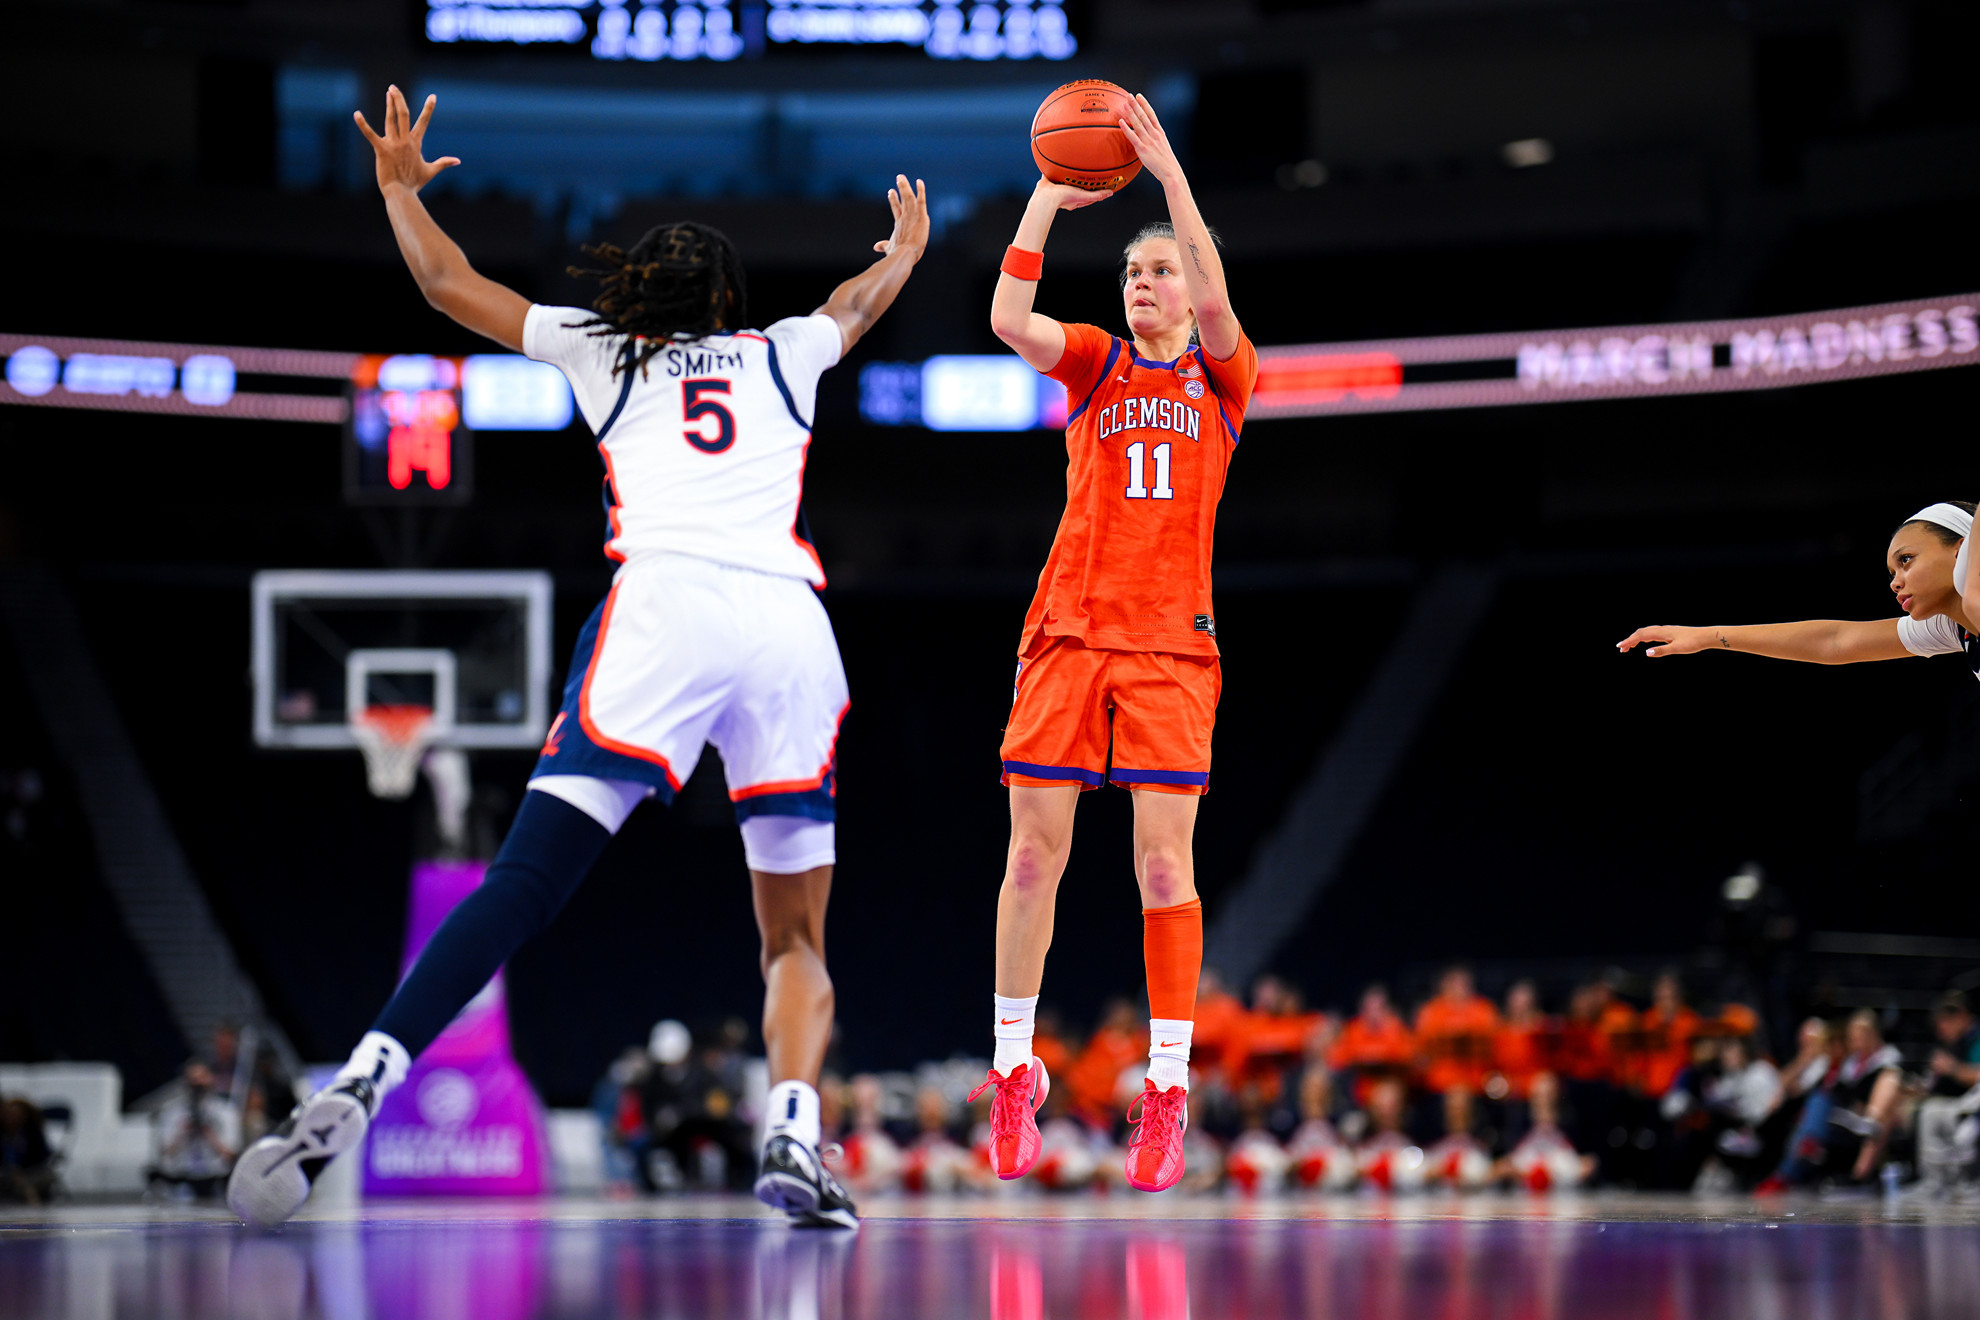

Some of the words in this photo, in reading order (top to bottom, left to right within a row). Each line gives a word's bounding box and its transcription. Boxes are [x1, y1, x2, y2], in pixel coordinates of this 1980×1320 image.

[667, 349, 744, 377] SMITH
[1517, 335, 1713, 391] MARCH
[1731, 306, 1979, 379] MADNESS
[681, 378, 737, 455] 5
[1099, 397, 1201, 443] CLEMSON
[1125, 441, 1174, 500] 11
